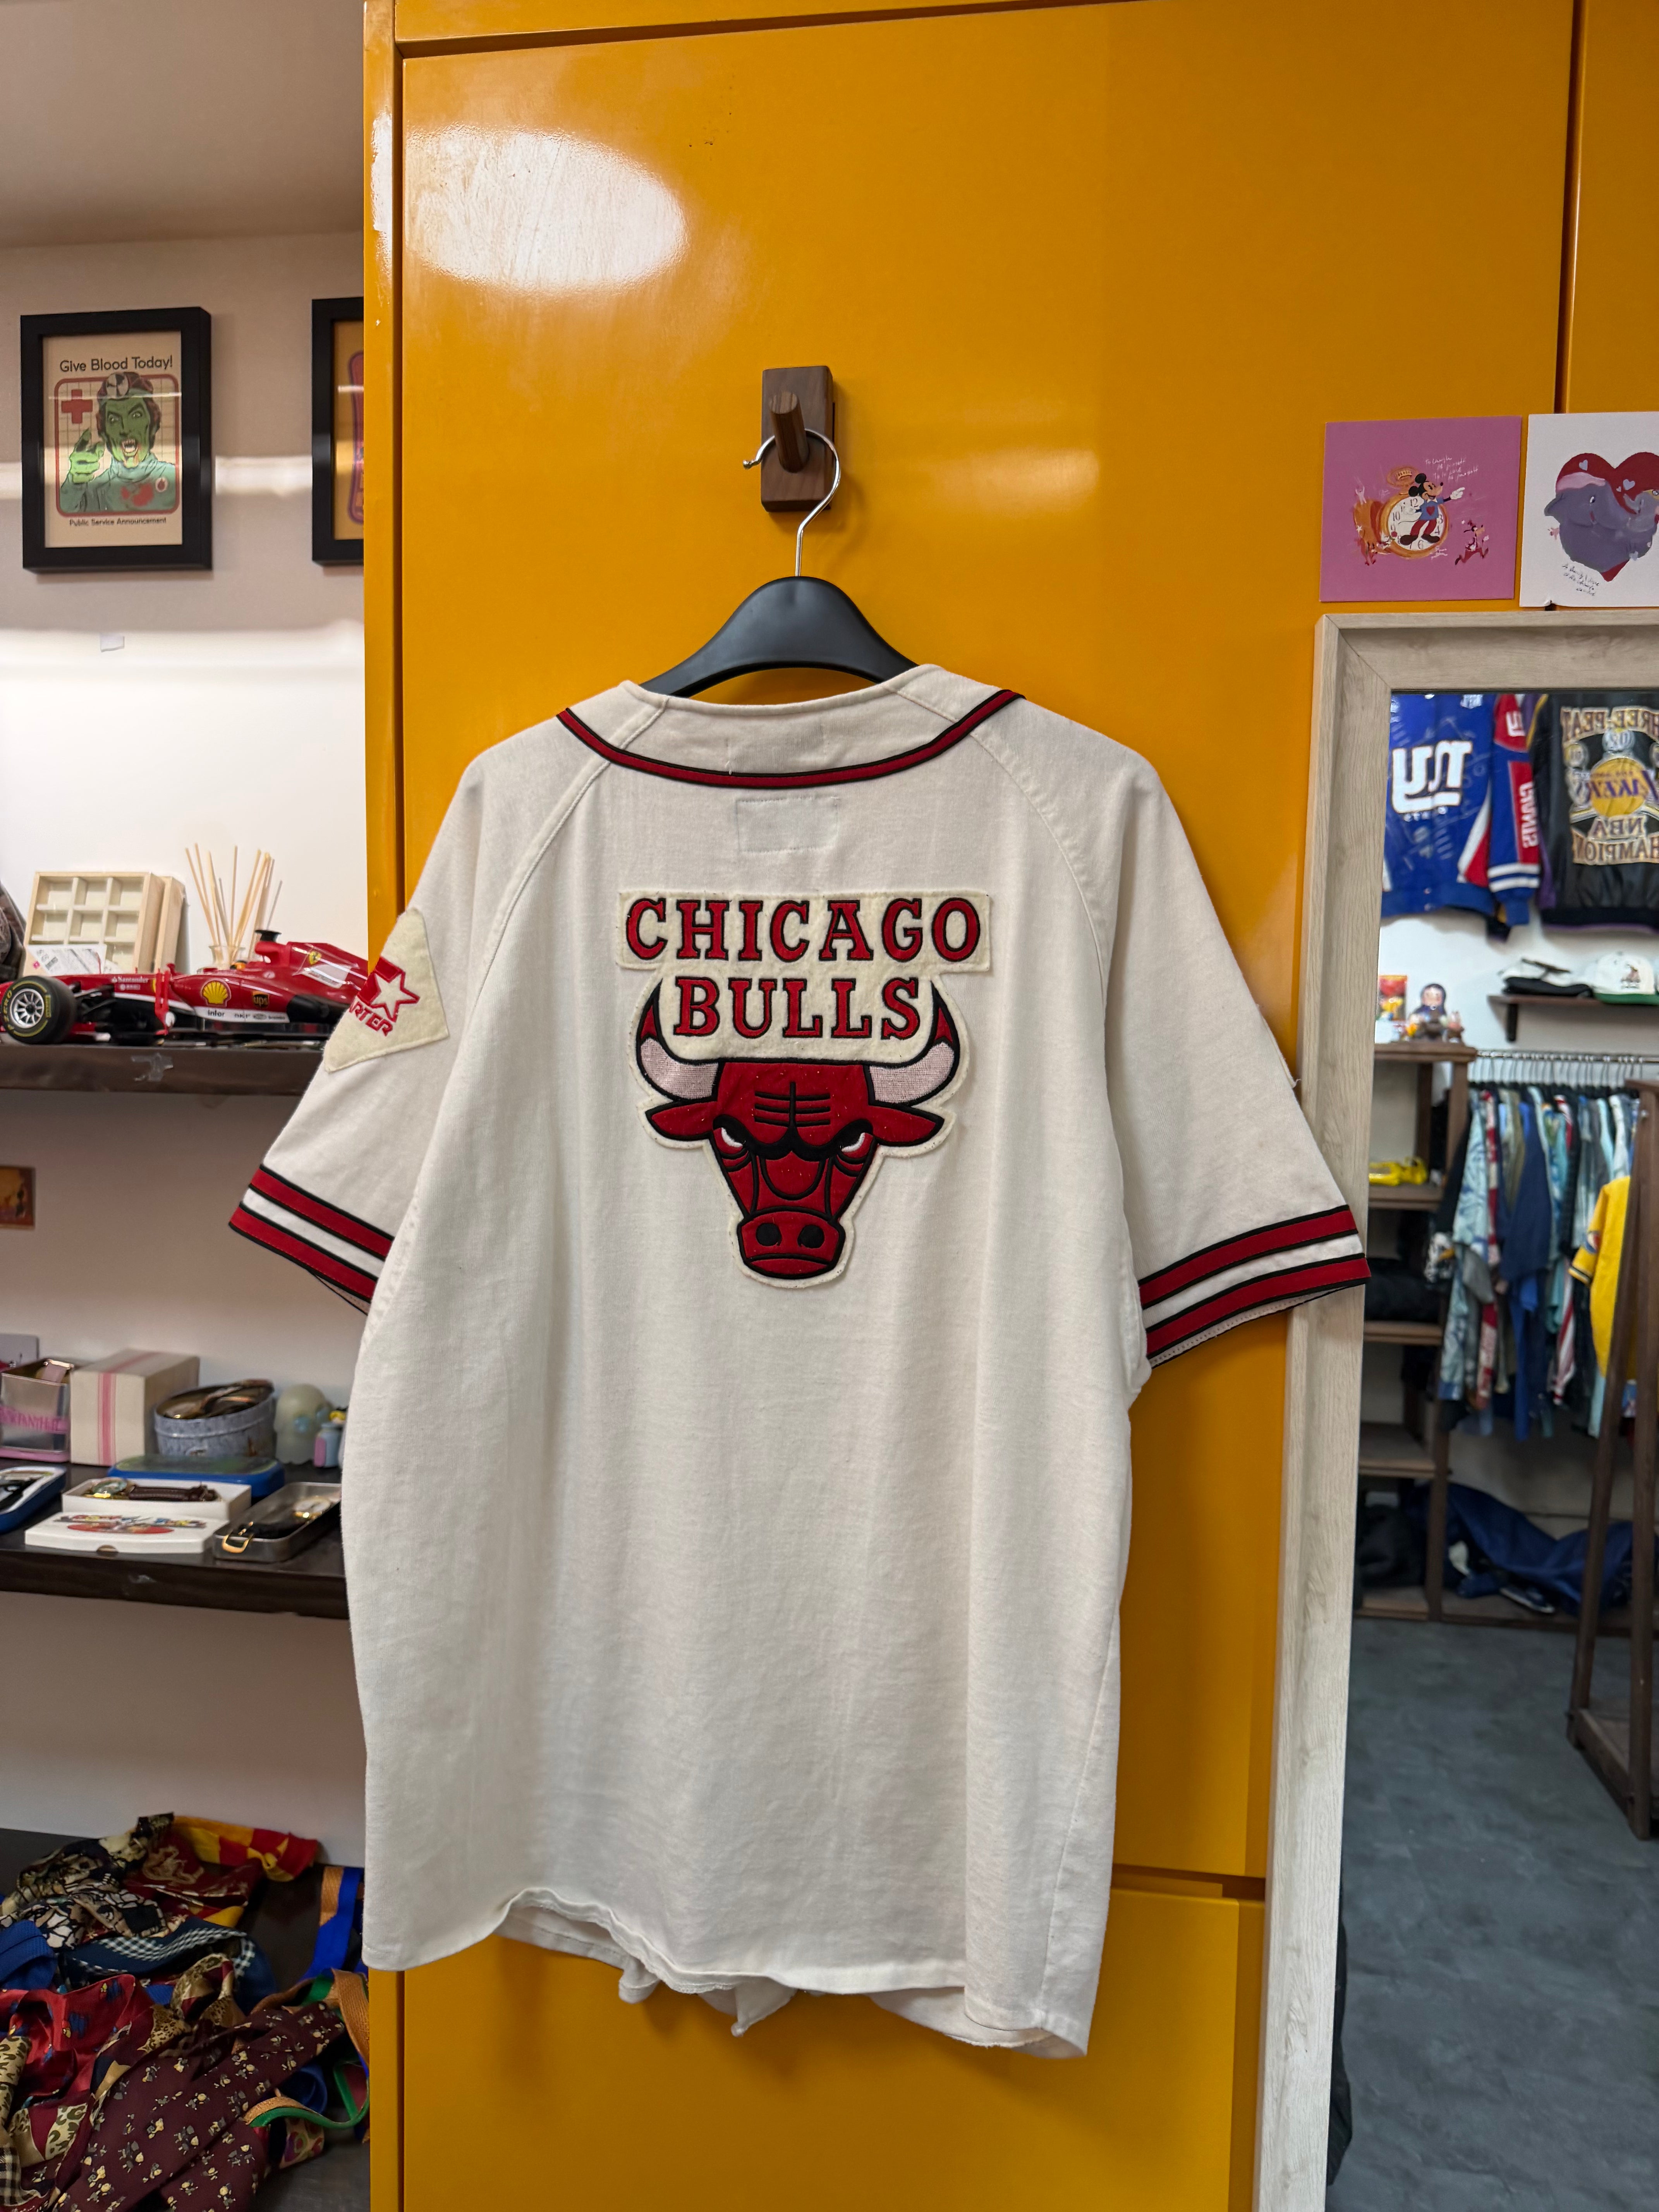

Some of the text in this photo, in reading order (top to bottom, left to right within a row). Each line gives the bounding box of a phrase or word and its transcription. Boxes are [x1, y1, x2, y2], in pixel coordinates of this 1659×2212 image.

[60, 355, 173, 372] Give Blood Today!
[1410, 498, 1419, 507] 12
[1393, 511, 1400, 521] 10
[625, 897, 981, 963] CHICAGO
[349, 1001, 393, 1037] RTER
[673, 977, 922, 1041] BULLS
